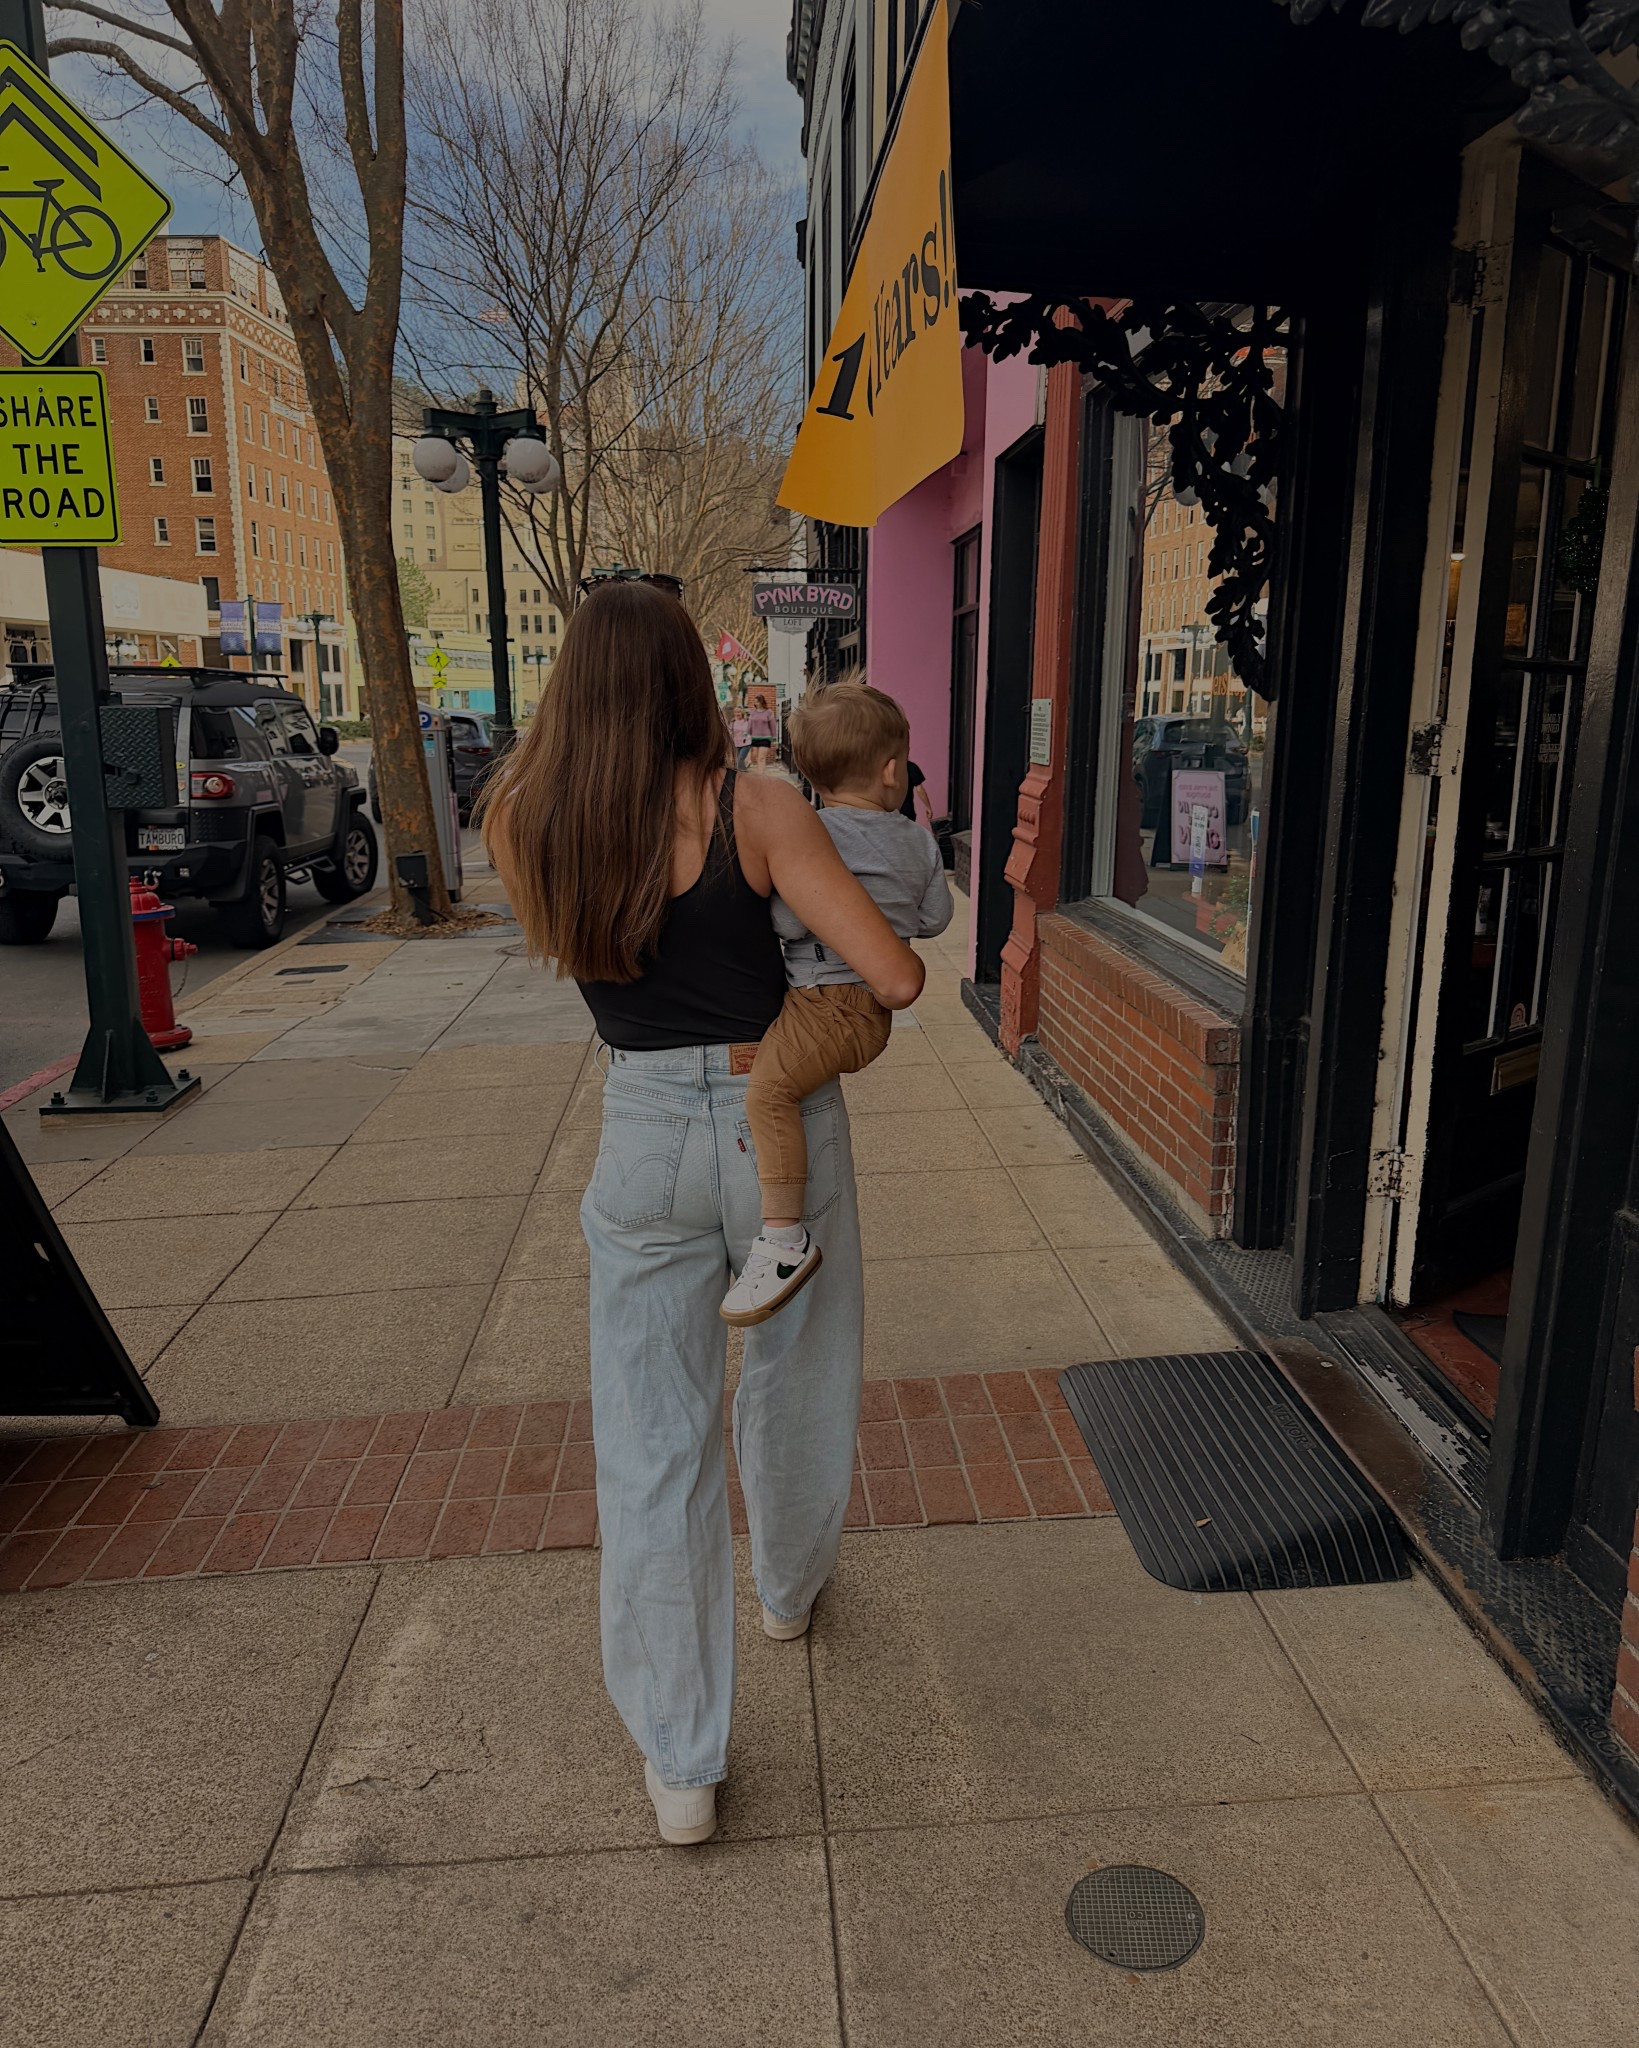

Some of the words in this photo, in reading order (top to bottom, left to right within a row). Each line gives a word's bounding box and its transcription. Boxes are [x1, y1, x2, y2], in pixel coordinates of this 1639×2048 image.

[816, 320, 874, 421] 1
[12, 444, 84, 475] THE
[2, 487, 105, 519] ROAD
[755, 586, 804, 610] PYNK
[806, 585, 853, 610] BYRD
[774, 606, 833, 615] BOUTIQUE
[783, 618, 802, 626] LOFT
[419, 714, 429, 727] P
[1272, 1403, 1309, 1445] VEVOR
